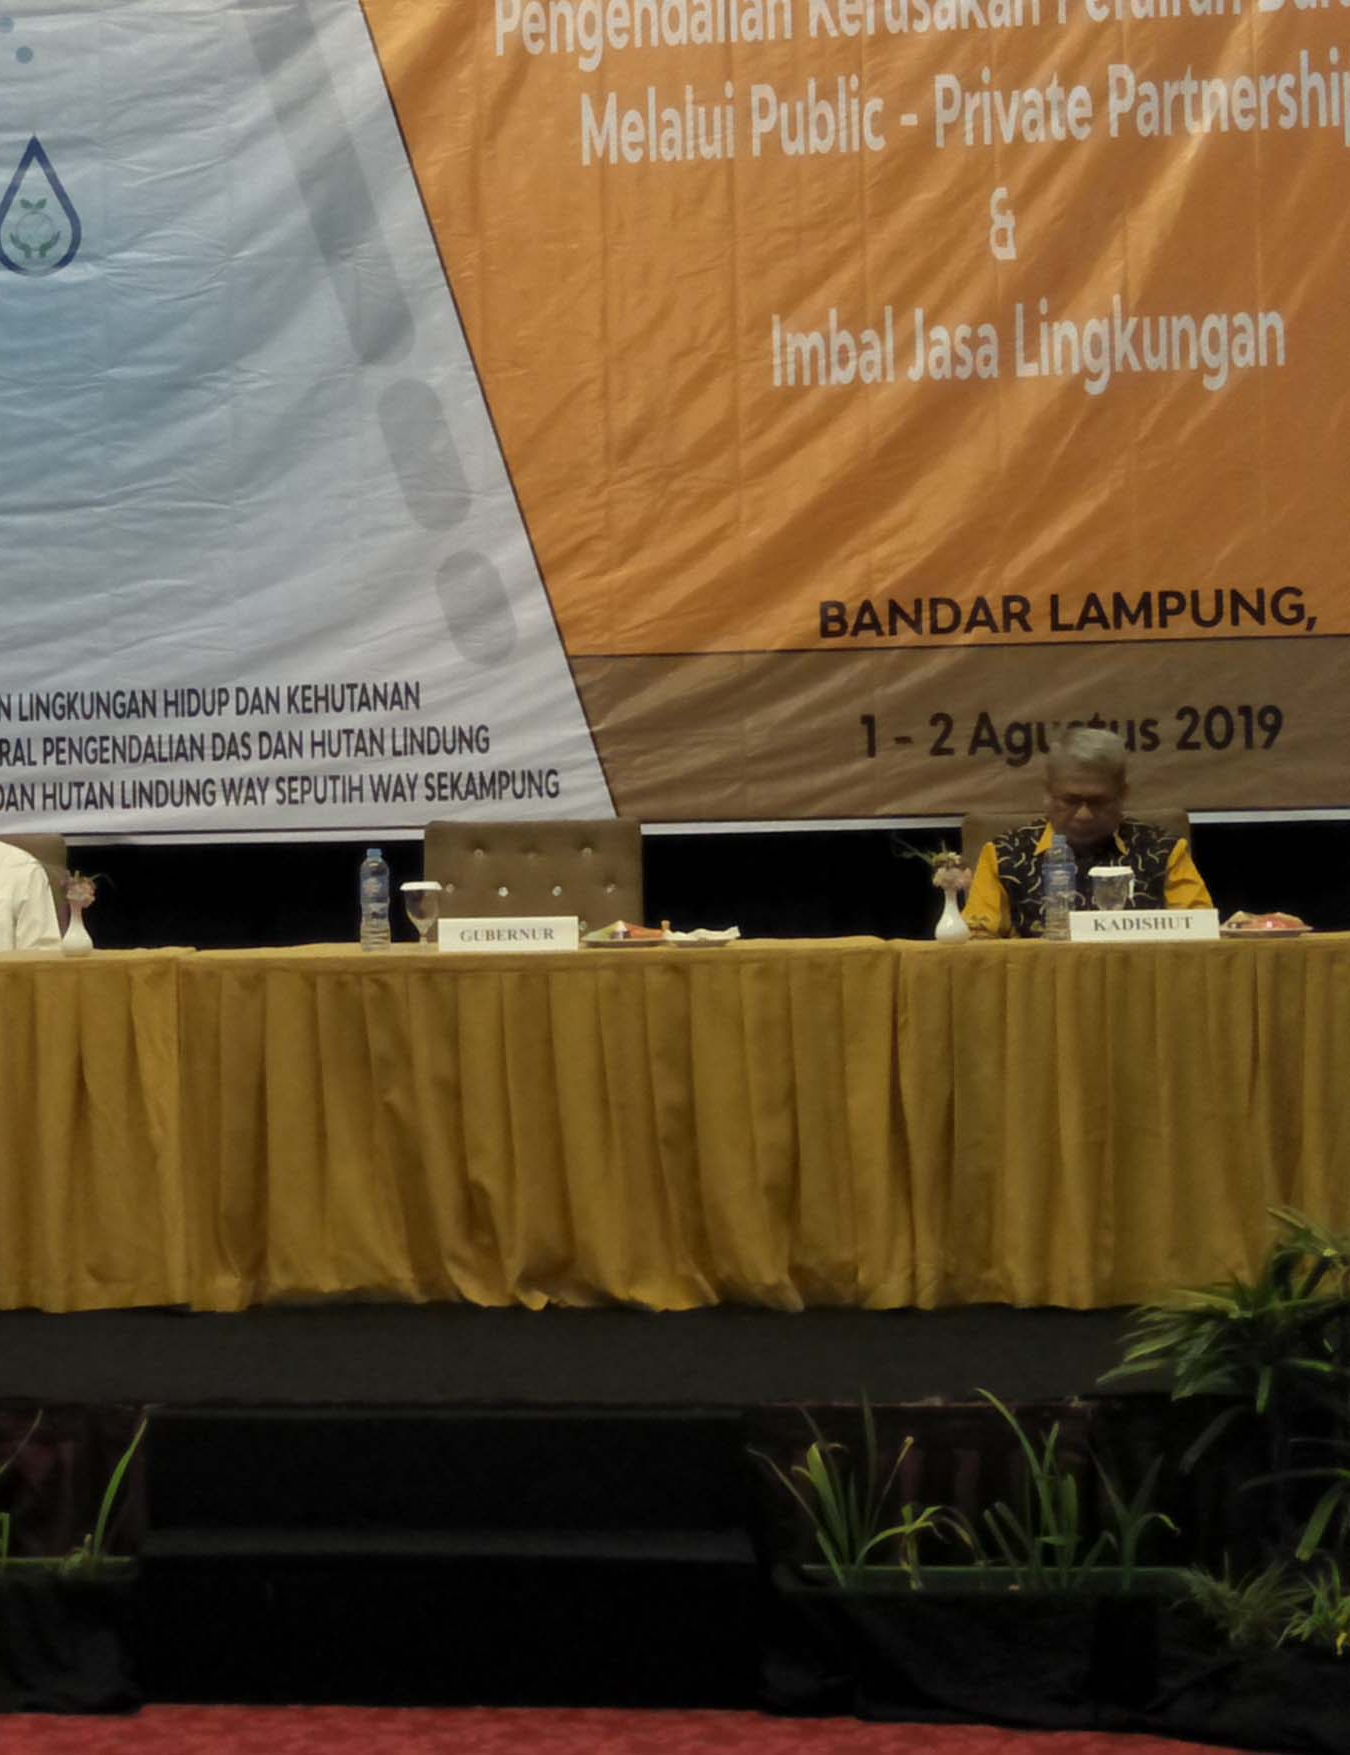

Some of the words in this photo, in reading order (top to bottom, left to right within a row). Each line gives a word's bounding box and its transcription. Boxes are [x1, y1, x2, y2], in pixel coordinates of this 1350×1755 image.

[581, 81, 735, 166] Melalui
[751, 74, 886, 157] Public
[934, 66, 1092, 148] Private
[989, 187, 1017, 260] &
[771, 305, 895, 386] Imbal
[907, 307, 999, 382] Jasa
[1014, 294, 1286, 396] Lingkungan
[818, 595, 1031, 639] BANDAR
[1049, 587, 1317, 632] LAMPUNG,
[17, 689, 157, 722] LINGKUNGAN
[163, 687, 230, 719] HIDUP
[235, 686, 281, 716] DAN
[287, 681, 421, 714] KEHUTANAN
[43, 732, 205, 767] PENGENDALIAN
[211, 730, 251, 762] DAS
[258, 729, 303, 760] DAN
[310, 727, 385, 759] HUTAN
[391, 724, 490, 757] LINDUNG
[860, 714, 877, 758] 1
[929, 712, 955, 757] 2
[967, 711, 1161, 768] Aguus
[1175, 705, 1284, 752] 2019
[41, 780, 115, 811] HUTAN
[121, 778, 217, 810] LINDUNG
[221, 776, 268, 806] WAY
[275, 774, 364, 805] SEPUTIH
[369, 773, 419, 803] WAY
[424, 768, 561, 803] SEKAMPUNG
[459, 928, 555, 943] GUBERNUR
[1093, 916, 1194, 932] KADISHUT
